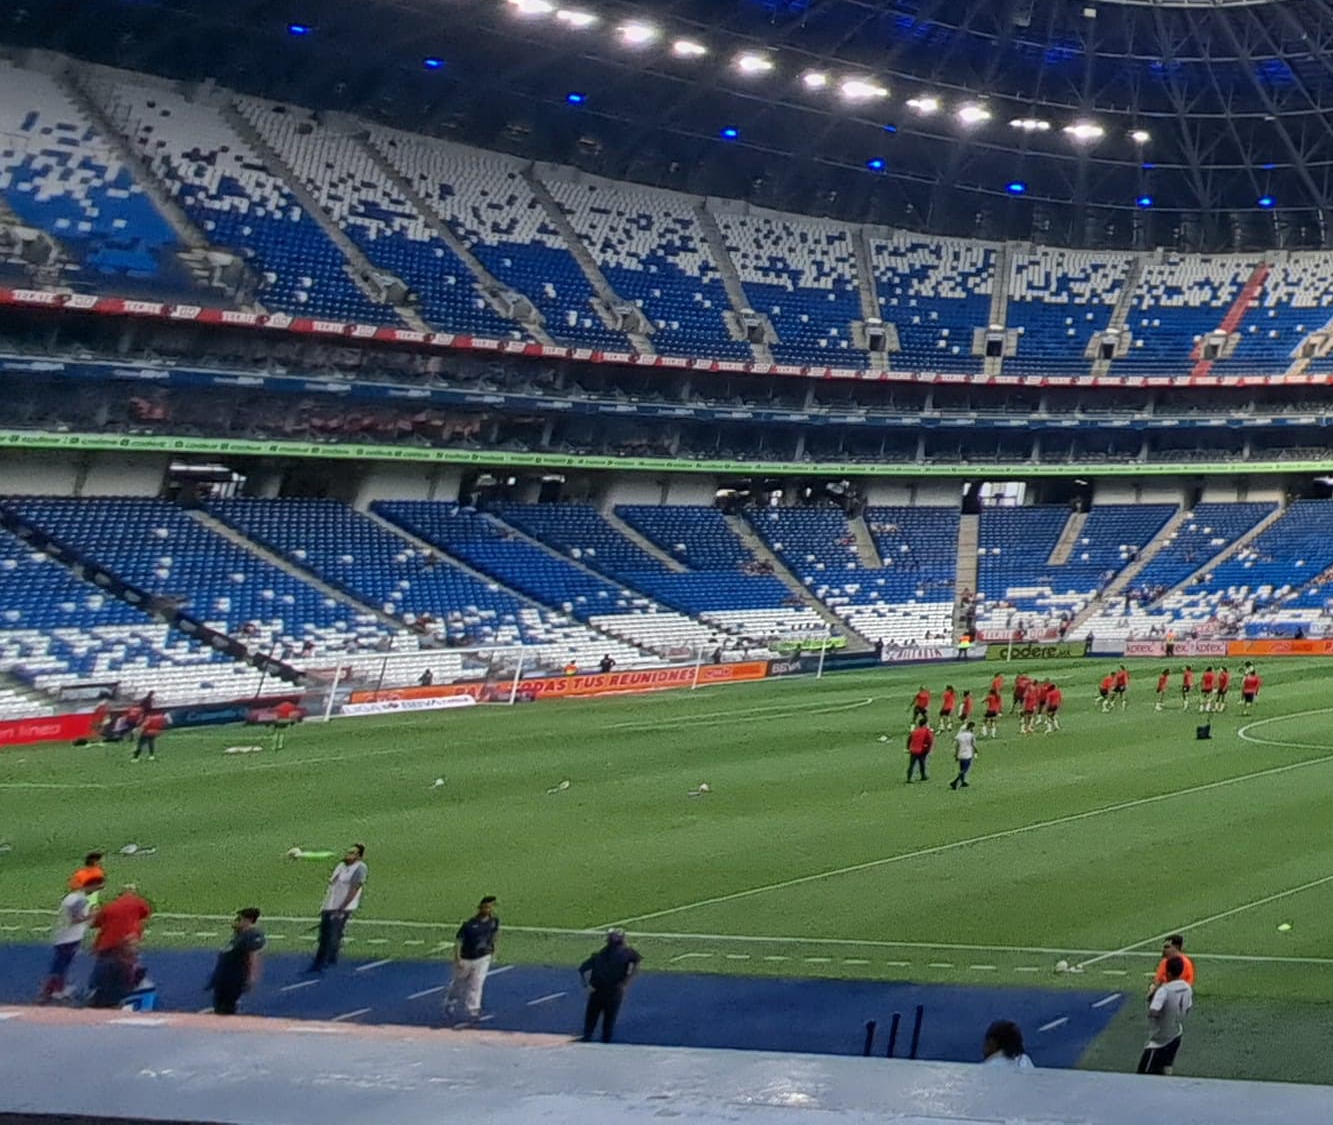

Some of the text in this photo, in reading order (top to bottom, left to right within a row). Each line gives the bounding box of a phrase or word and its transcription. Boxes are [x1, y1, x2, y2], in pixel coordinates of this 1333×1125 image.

[1196, 641, 1224, 653] kotex
[573, 673, 605, 688] TUS
[609, 668, 697, 686] REUNIONES
